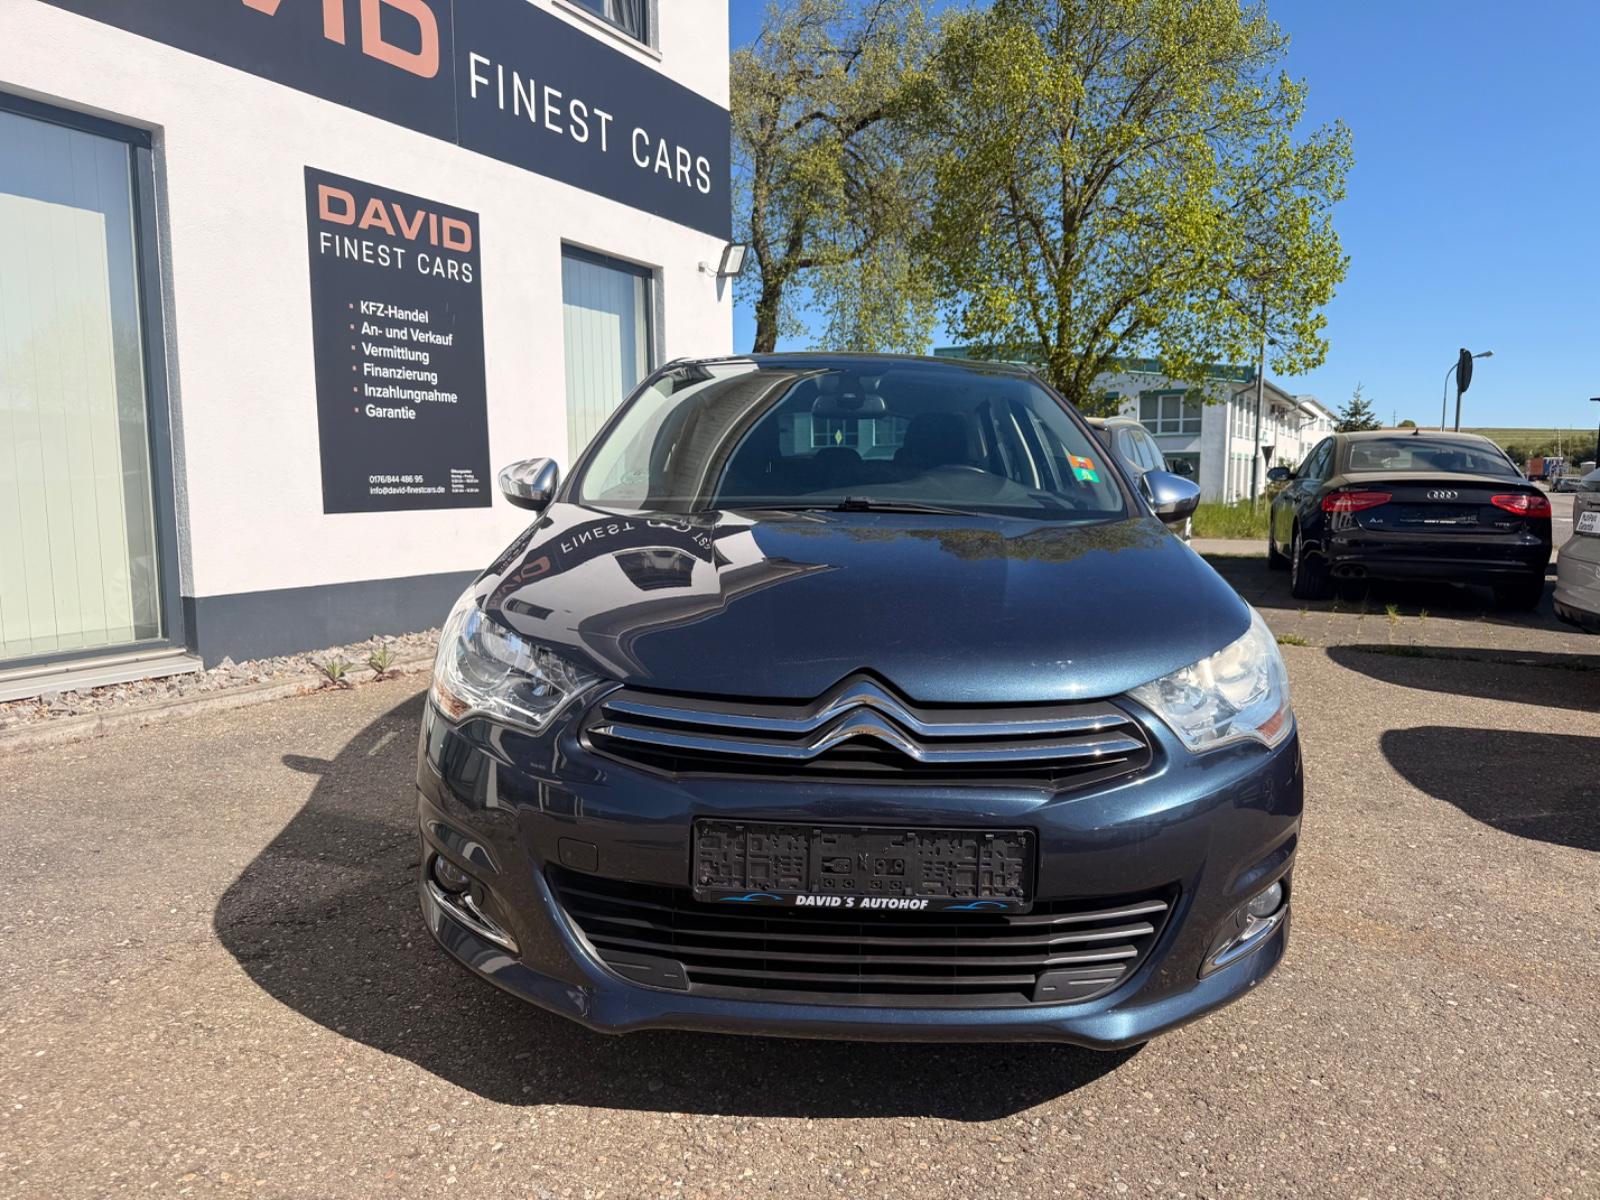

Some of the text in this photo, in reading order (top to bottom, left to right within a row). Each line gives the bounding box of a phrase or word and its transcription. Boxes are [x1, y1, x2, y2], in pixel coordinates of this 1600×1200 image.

[468, 52, 613, 153] FINEST
[632, 128, 712, 195] CARS
[318, 184, 472, 253] DAVID
[320, 232, 473, 283] FINEST CARS
[360, 300, 429, 323] KFZ-Handel
[361, 321, 453, 346] An- und Verkauf
[361, 342, 429, 365] Vermittlung
[363, 363, 438, 385] Finanzierung
[364, 383, 458, 403] Inzahlungnahme
[365, 404, 416, 419] Garantie
[860, 897, 929, 910] AUTOHOF
